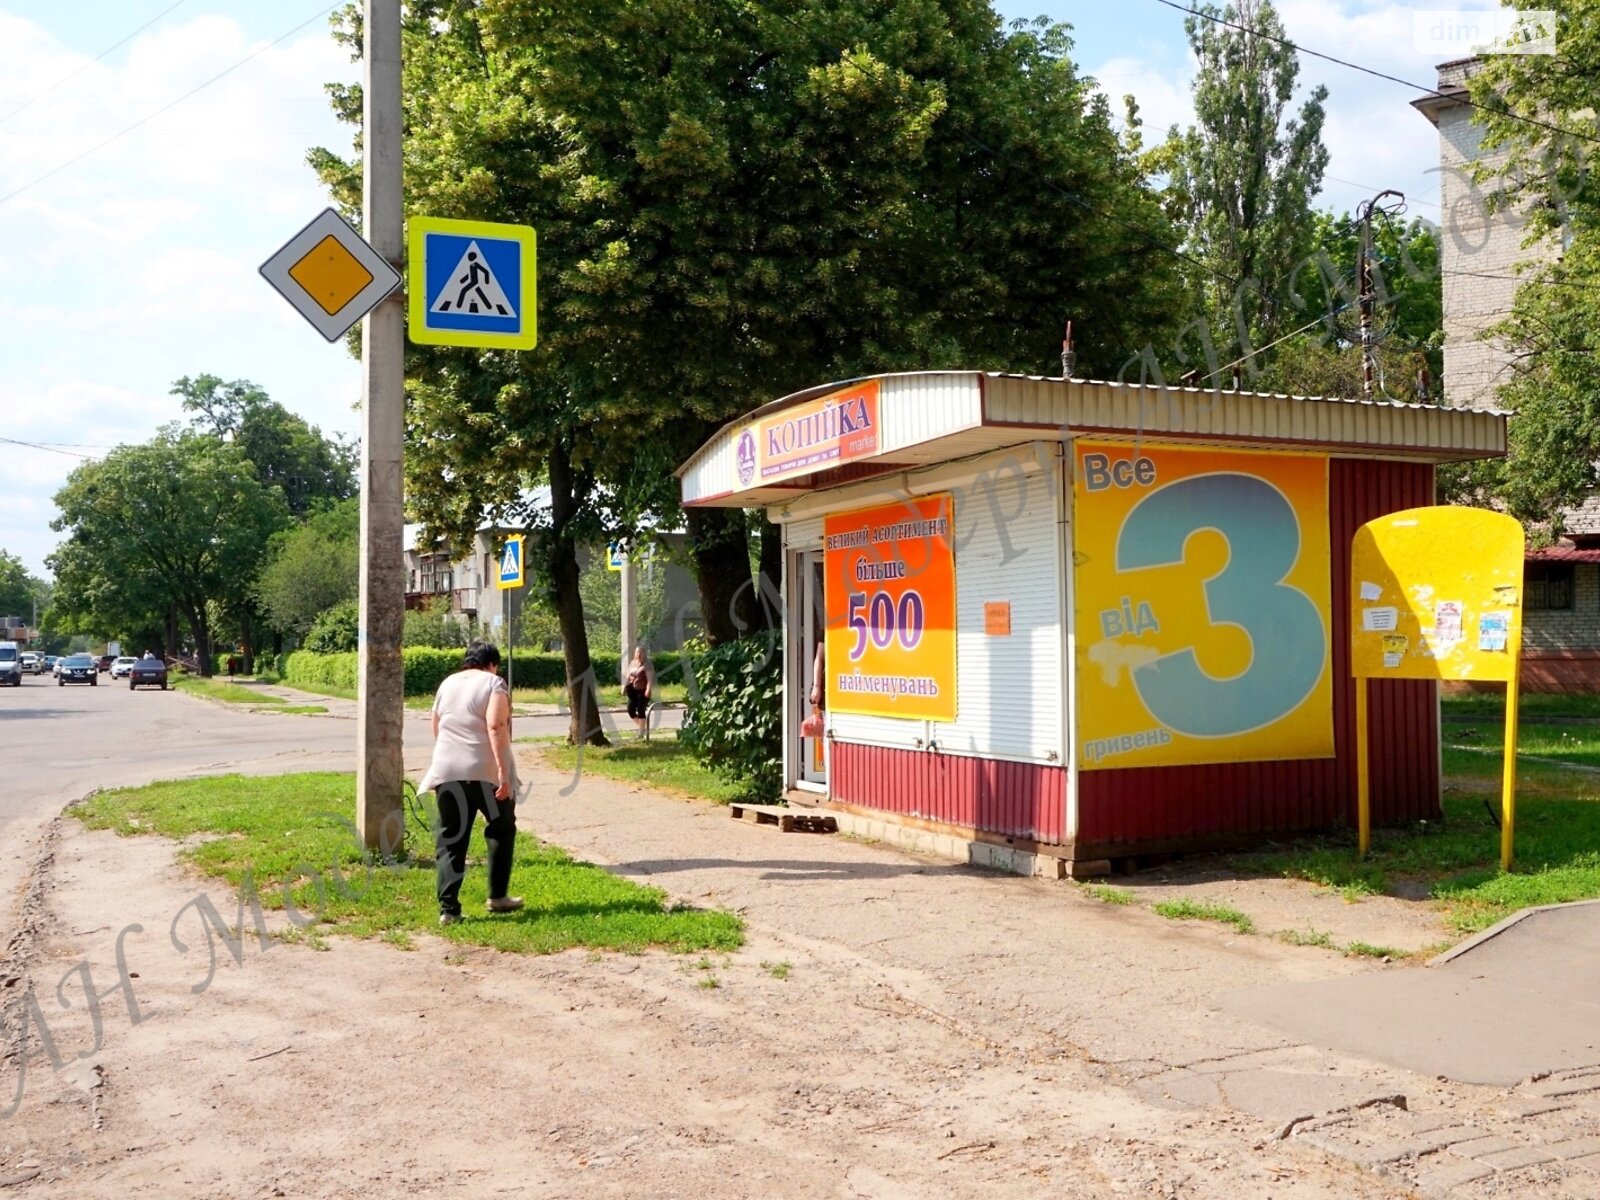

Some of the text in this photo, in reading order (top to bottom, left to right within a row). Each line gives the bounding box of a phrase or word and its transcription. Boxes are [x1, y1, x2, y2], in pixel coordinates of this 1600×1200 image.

[768, 395, 872, 457] КОПІЙКА
[1083, 452, 1156, 492] Все
[827, 518, 947, 550] ВЕЛИКИЙ АСОРТИМЕНТ
[856, 555, 905, 581] більше
[1100, 595, 1160, 638] від
[1116, 470, 1327, 740] 3
[848, 590, 925, 662] 500
[838, 669, 938, 699] найменувань
[1084, 727, 1171, 762] гривень
